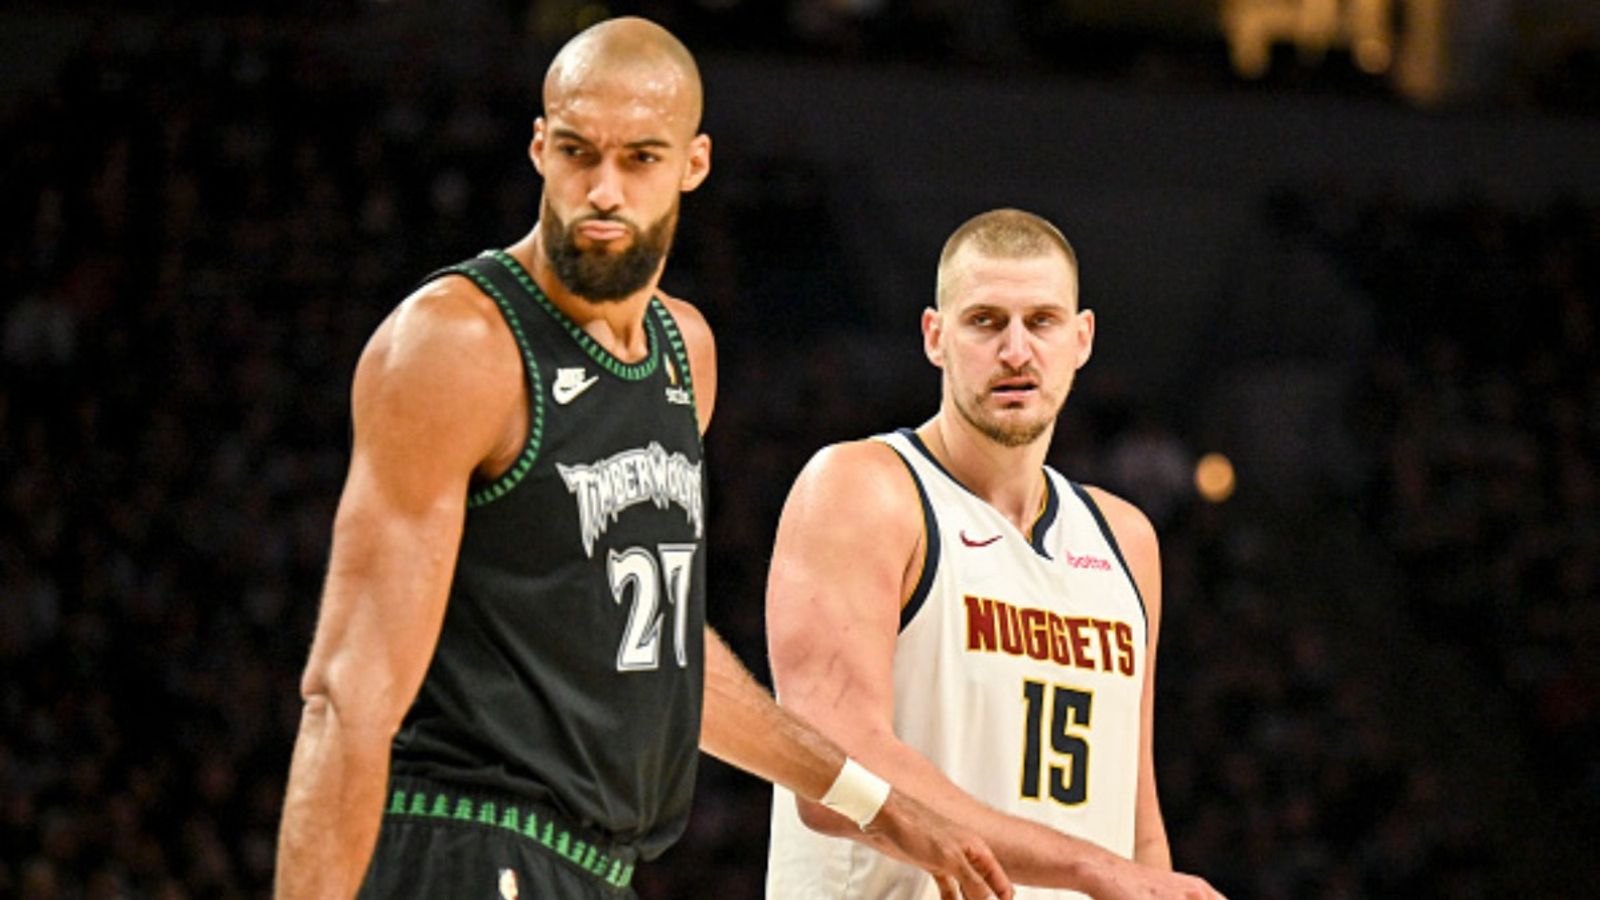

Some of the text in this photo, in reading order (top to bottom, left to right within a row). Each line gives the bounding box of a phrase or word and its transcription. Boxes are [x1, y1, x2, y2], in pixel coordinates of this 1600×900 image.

[606, 543, 698, 671] 27
[963, 595, 1136, 678] NUGGETS
[1020, 677, 1095, 806] 15
